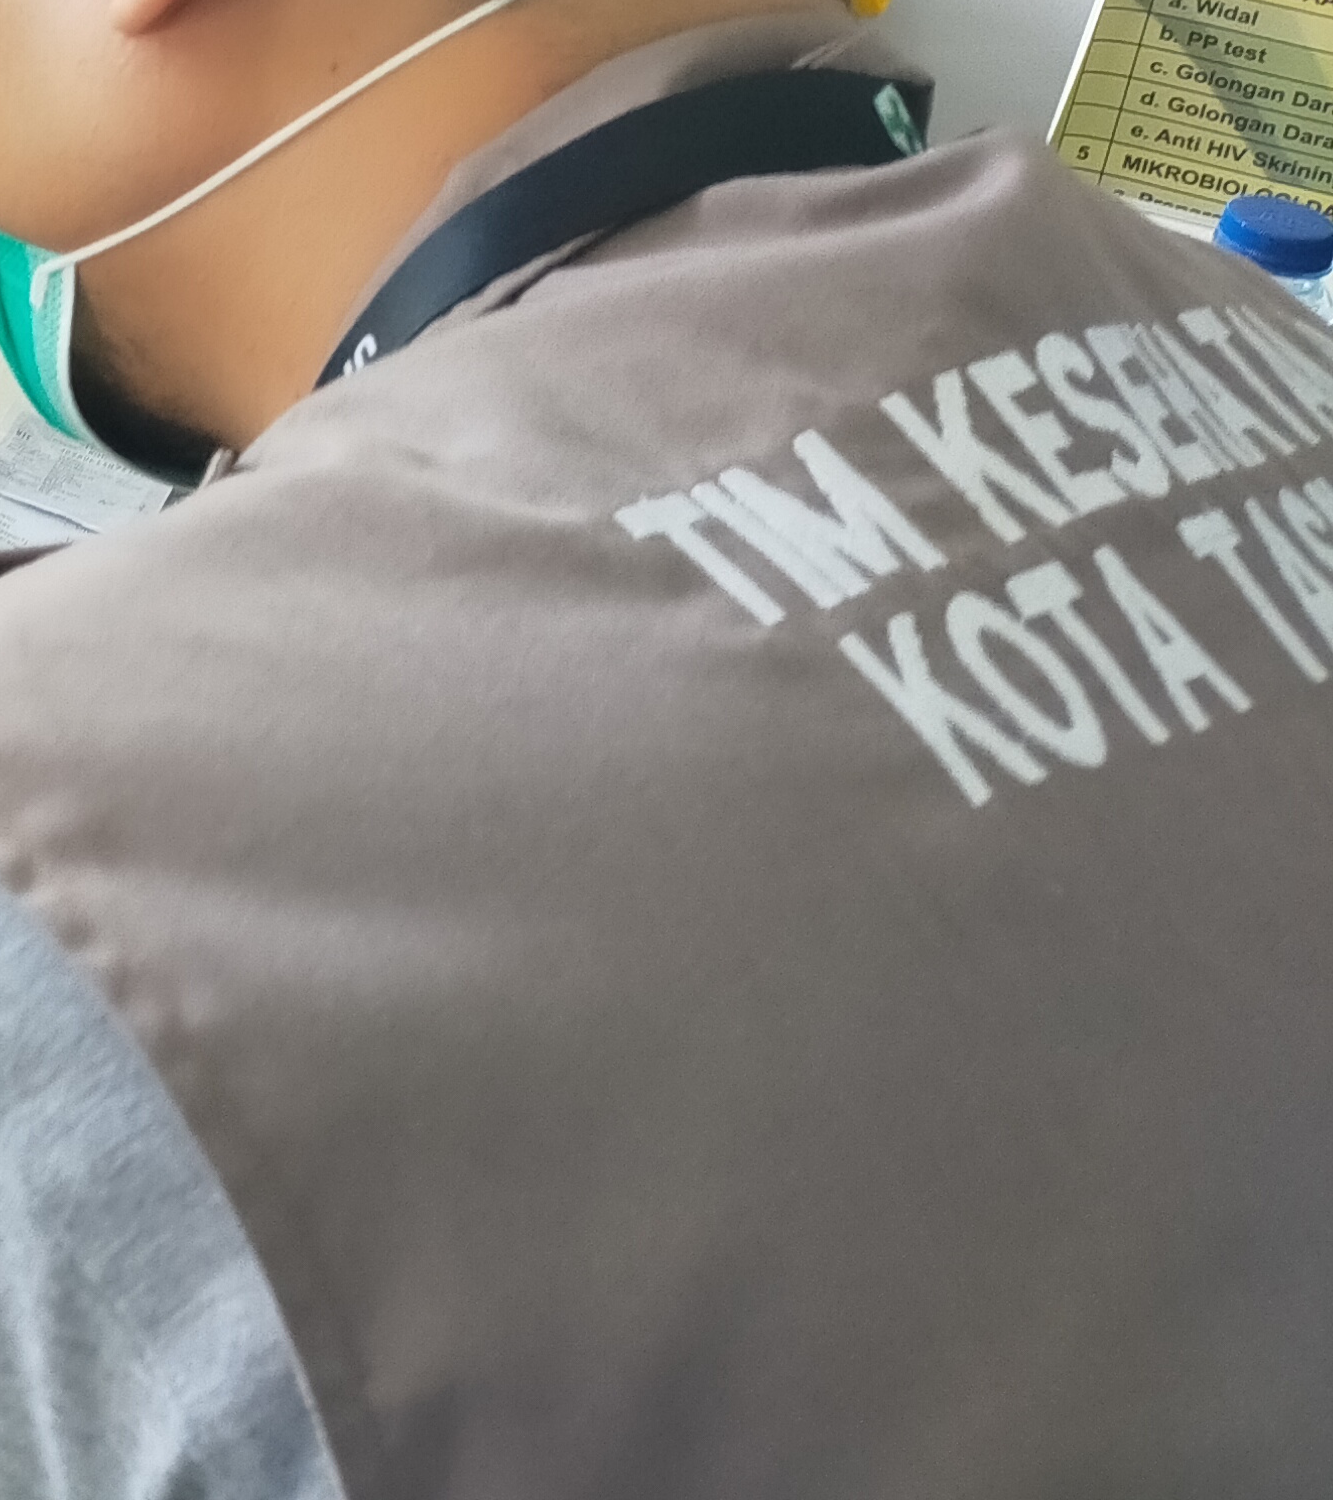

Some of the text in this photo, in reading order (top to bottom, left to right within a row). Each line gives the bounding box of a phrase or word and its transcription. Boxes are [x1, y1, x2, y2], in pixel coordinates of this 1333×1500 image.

[1158, 25, 1268, 65] b. PP test
[1140, 90, 1158, 108] d.
[1167, 96, 1276, 136] Golongan
[1150, 60, 1333, 115] c. Golongan Dar
[1076, 145, 1090, 161] 5
[1130, 124, 1333, 188] e. Anti HIV Skrinin
[613, 304, 1333, 627] TIM KESEHATA
[839, 544, 1252, 807] KOTA
